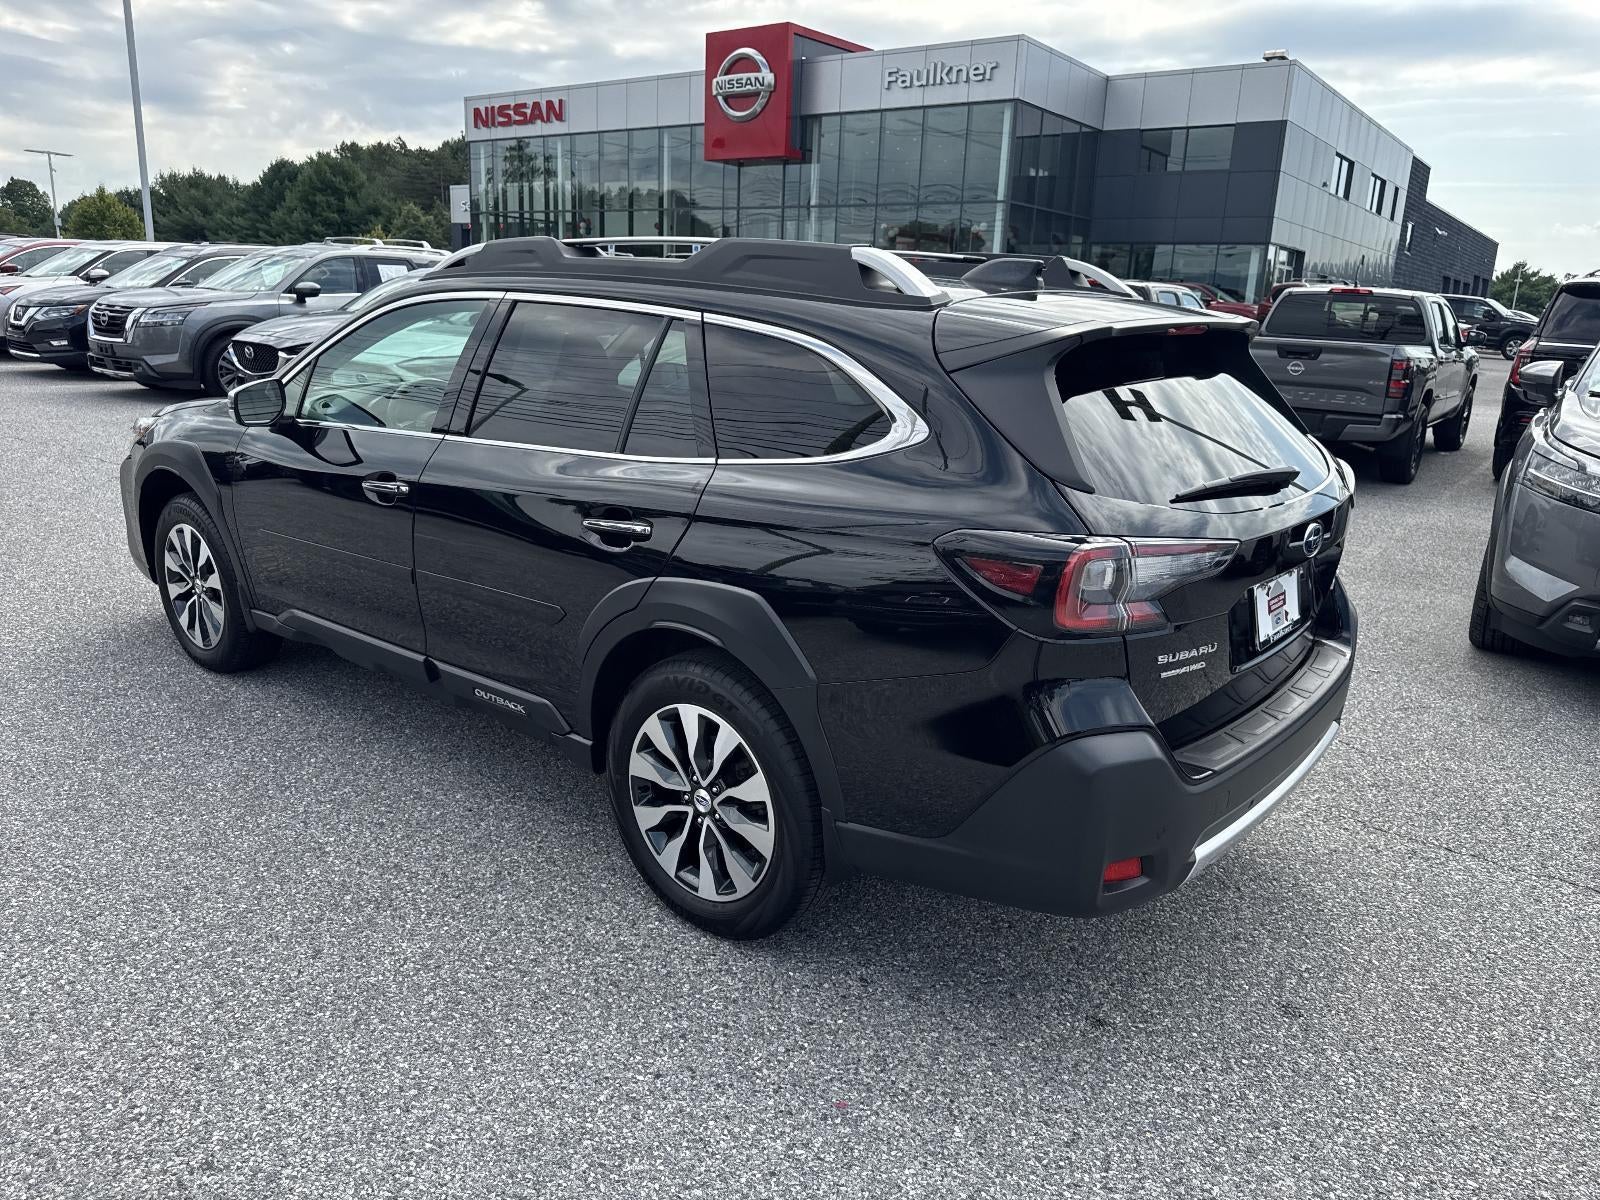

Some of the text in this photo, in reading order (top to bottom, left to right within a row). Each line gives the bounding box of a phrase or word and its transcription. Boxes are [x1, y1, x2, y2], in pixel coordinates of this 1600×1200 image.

[715, 76, 765, 91] NISSAN
[884, 60, 998, 90] Faulkner
[473, 98, 564, 129] NISSAN
[1157, 642, 1218, 665] SUBARU
[1179, 661, 1206, 675] AWD
[474, 688, 526, 714] OUTBACK
